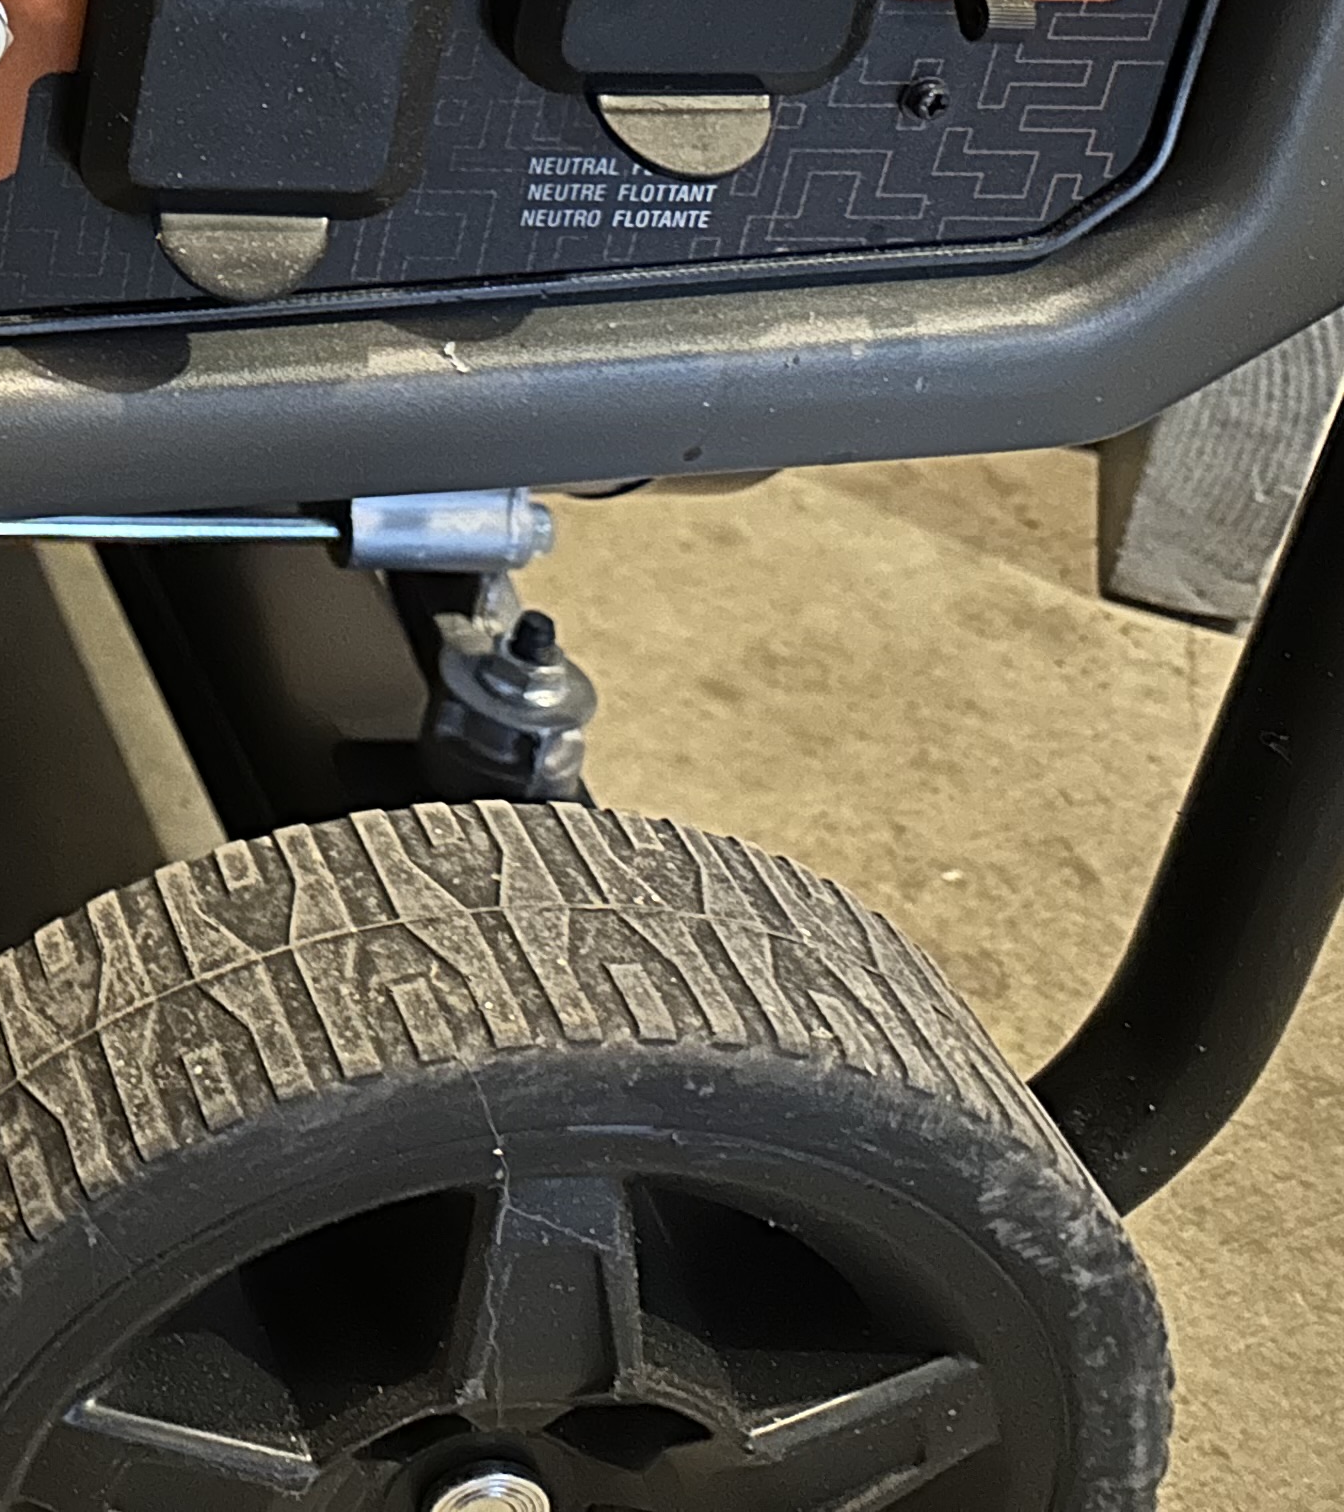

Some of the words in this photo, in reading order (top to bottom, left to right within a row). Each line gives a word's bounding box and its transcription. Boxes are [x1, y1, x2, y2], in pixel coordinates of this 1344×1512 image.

[528, 157, 619, 176] NEUTRAL
[527, 183, 607, 202] NEUTRE
[617, 184, 718, 203] FLOTTANT
[520, 209, 601, 228] NEUTRO
[612, 210, 711, 228] FLOTANTE
